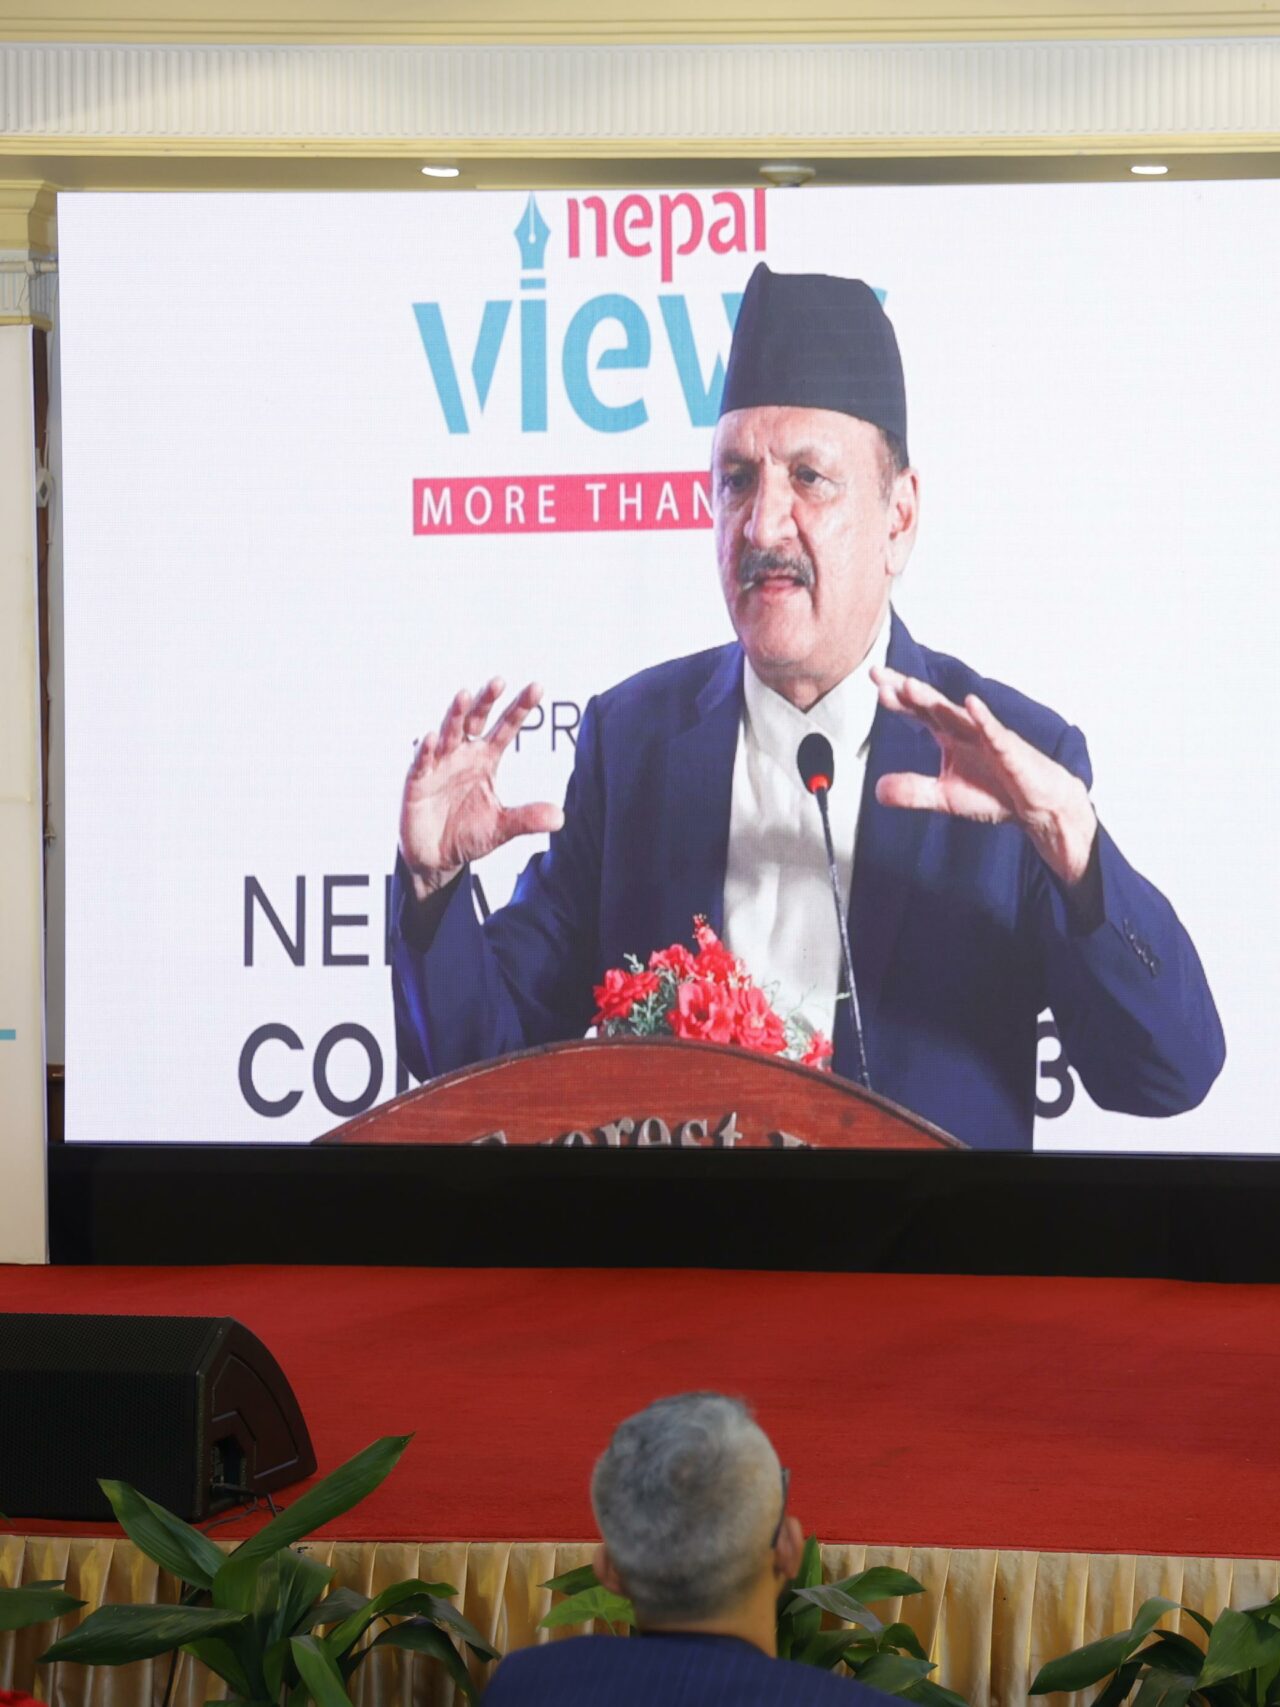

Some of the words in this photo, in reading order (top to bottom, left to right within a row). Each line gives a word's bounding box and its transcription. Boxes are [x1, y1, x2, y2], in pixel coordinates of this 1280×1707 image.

[568, 188, 767, 284] nepal
[421, 484, 556, 527] MORE
[585, 480, 714, 524] THAN
